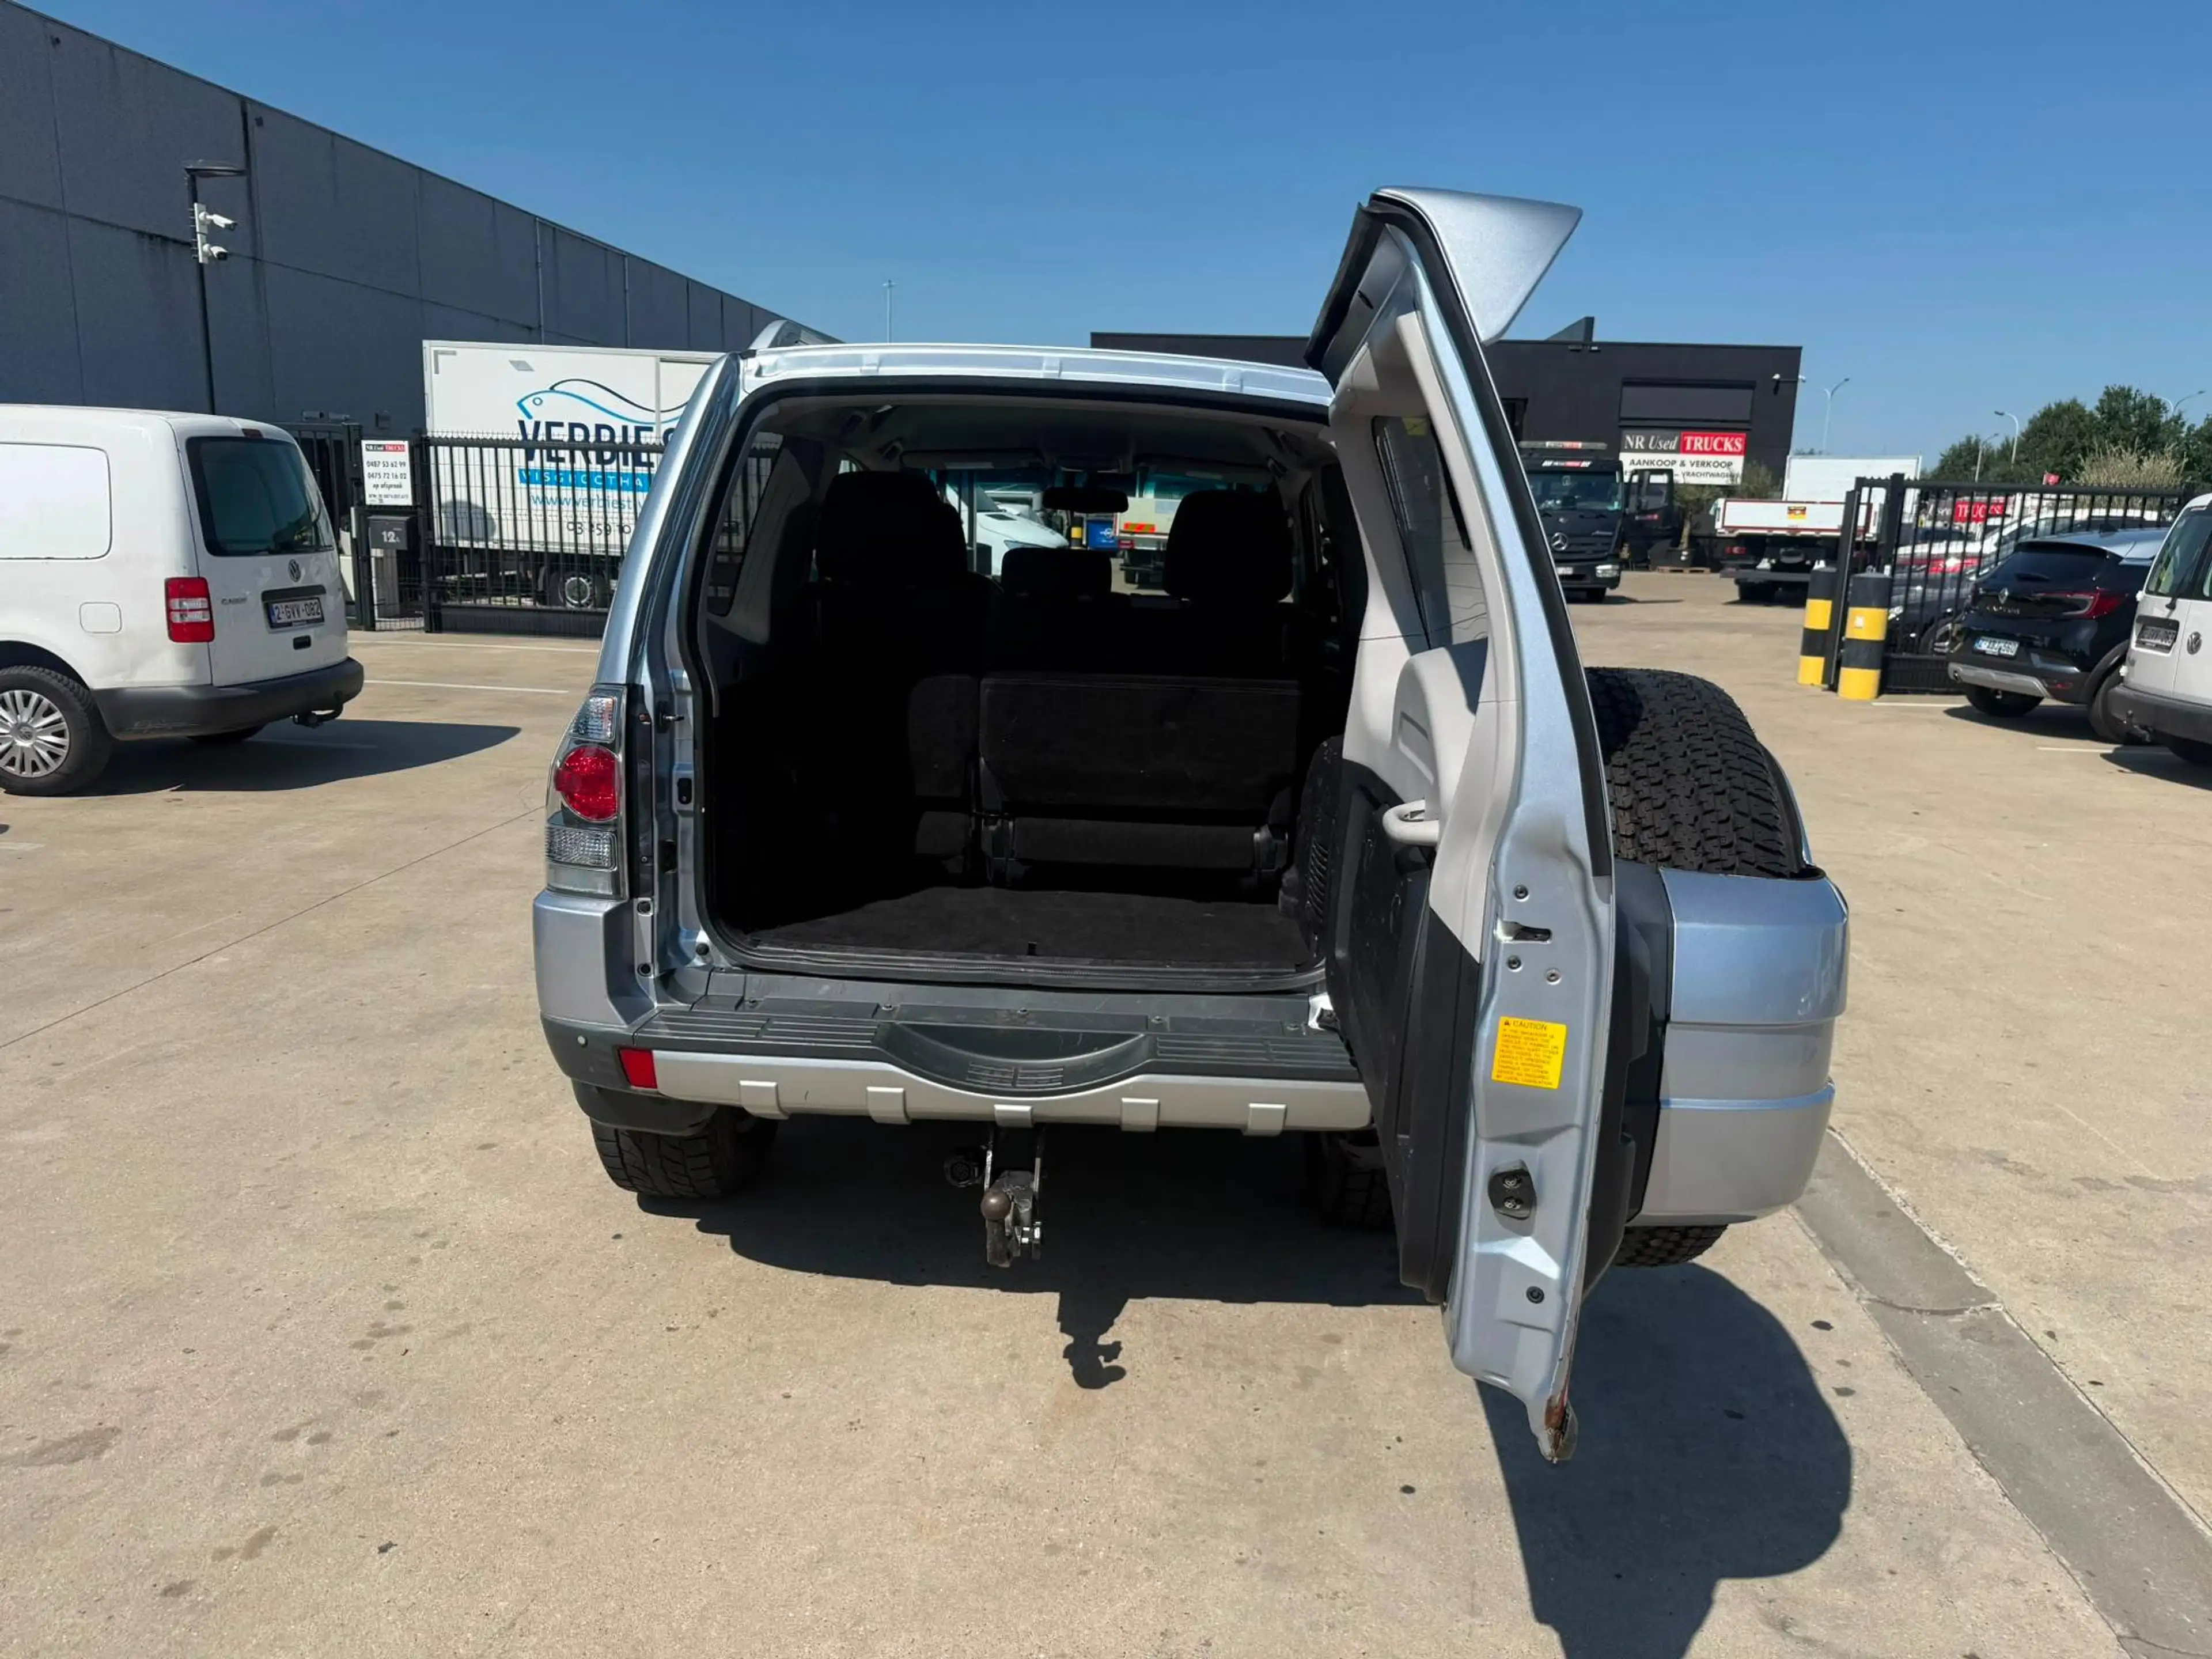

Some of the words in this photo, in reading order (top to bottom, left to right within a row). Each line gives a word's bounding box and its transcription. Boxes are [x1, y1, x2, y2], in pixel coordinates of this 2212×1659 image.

[1624, 435, 1645, 449] NR
[1649, 435, 1679, 450] Used
[1684, 436, 1743, 452] TRUCKS
[1629, 459, 1676, 467] AANKOOP
[1690, 460, 1733, 469] VERKOOP
[1513, 1020, 1547, 1031] CAUTION
